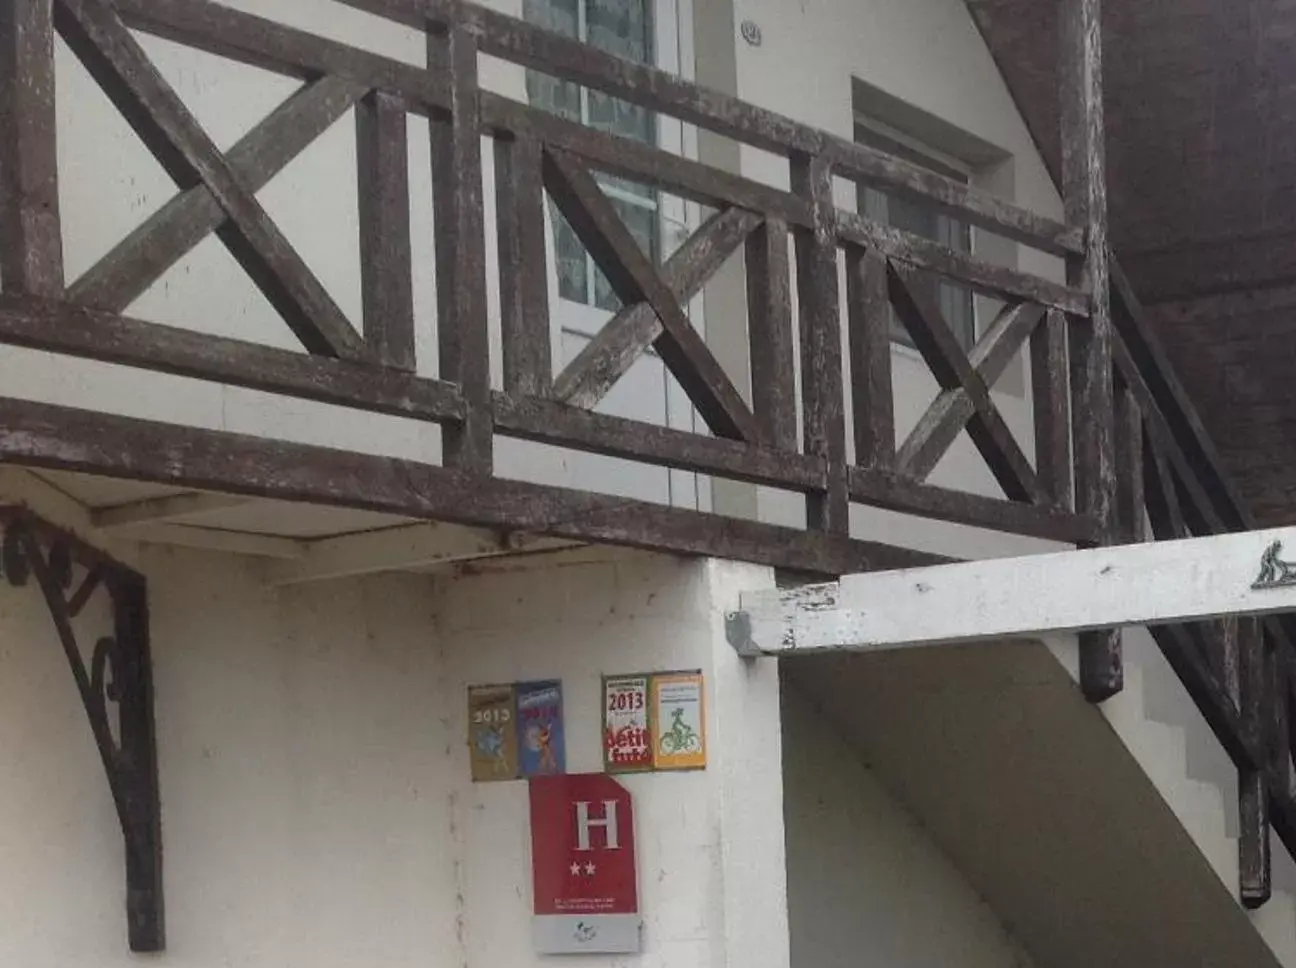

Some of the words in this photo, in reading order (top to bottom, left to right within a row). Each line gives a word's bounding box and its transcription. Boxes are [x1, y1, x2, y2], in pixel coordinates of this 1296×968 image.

[608, 692, 644, 711] 2013
[473, 708, 511, 723] 2013
[573, 799, 622, 851] H
